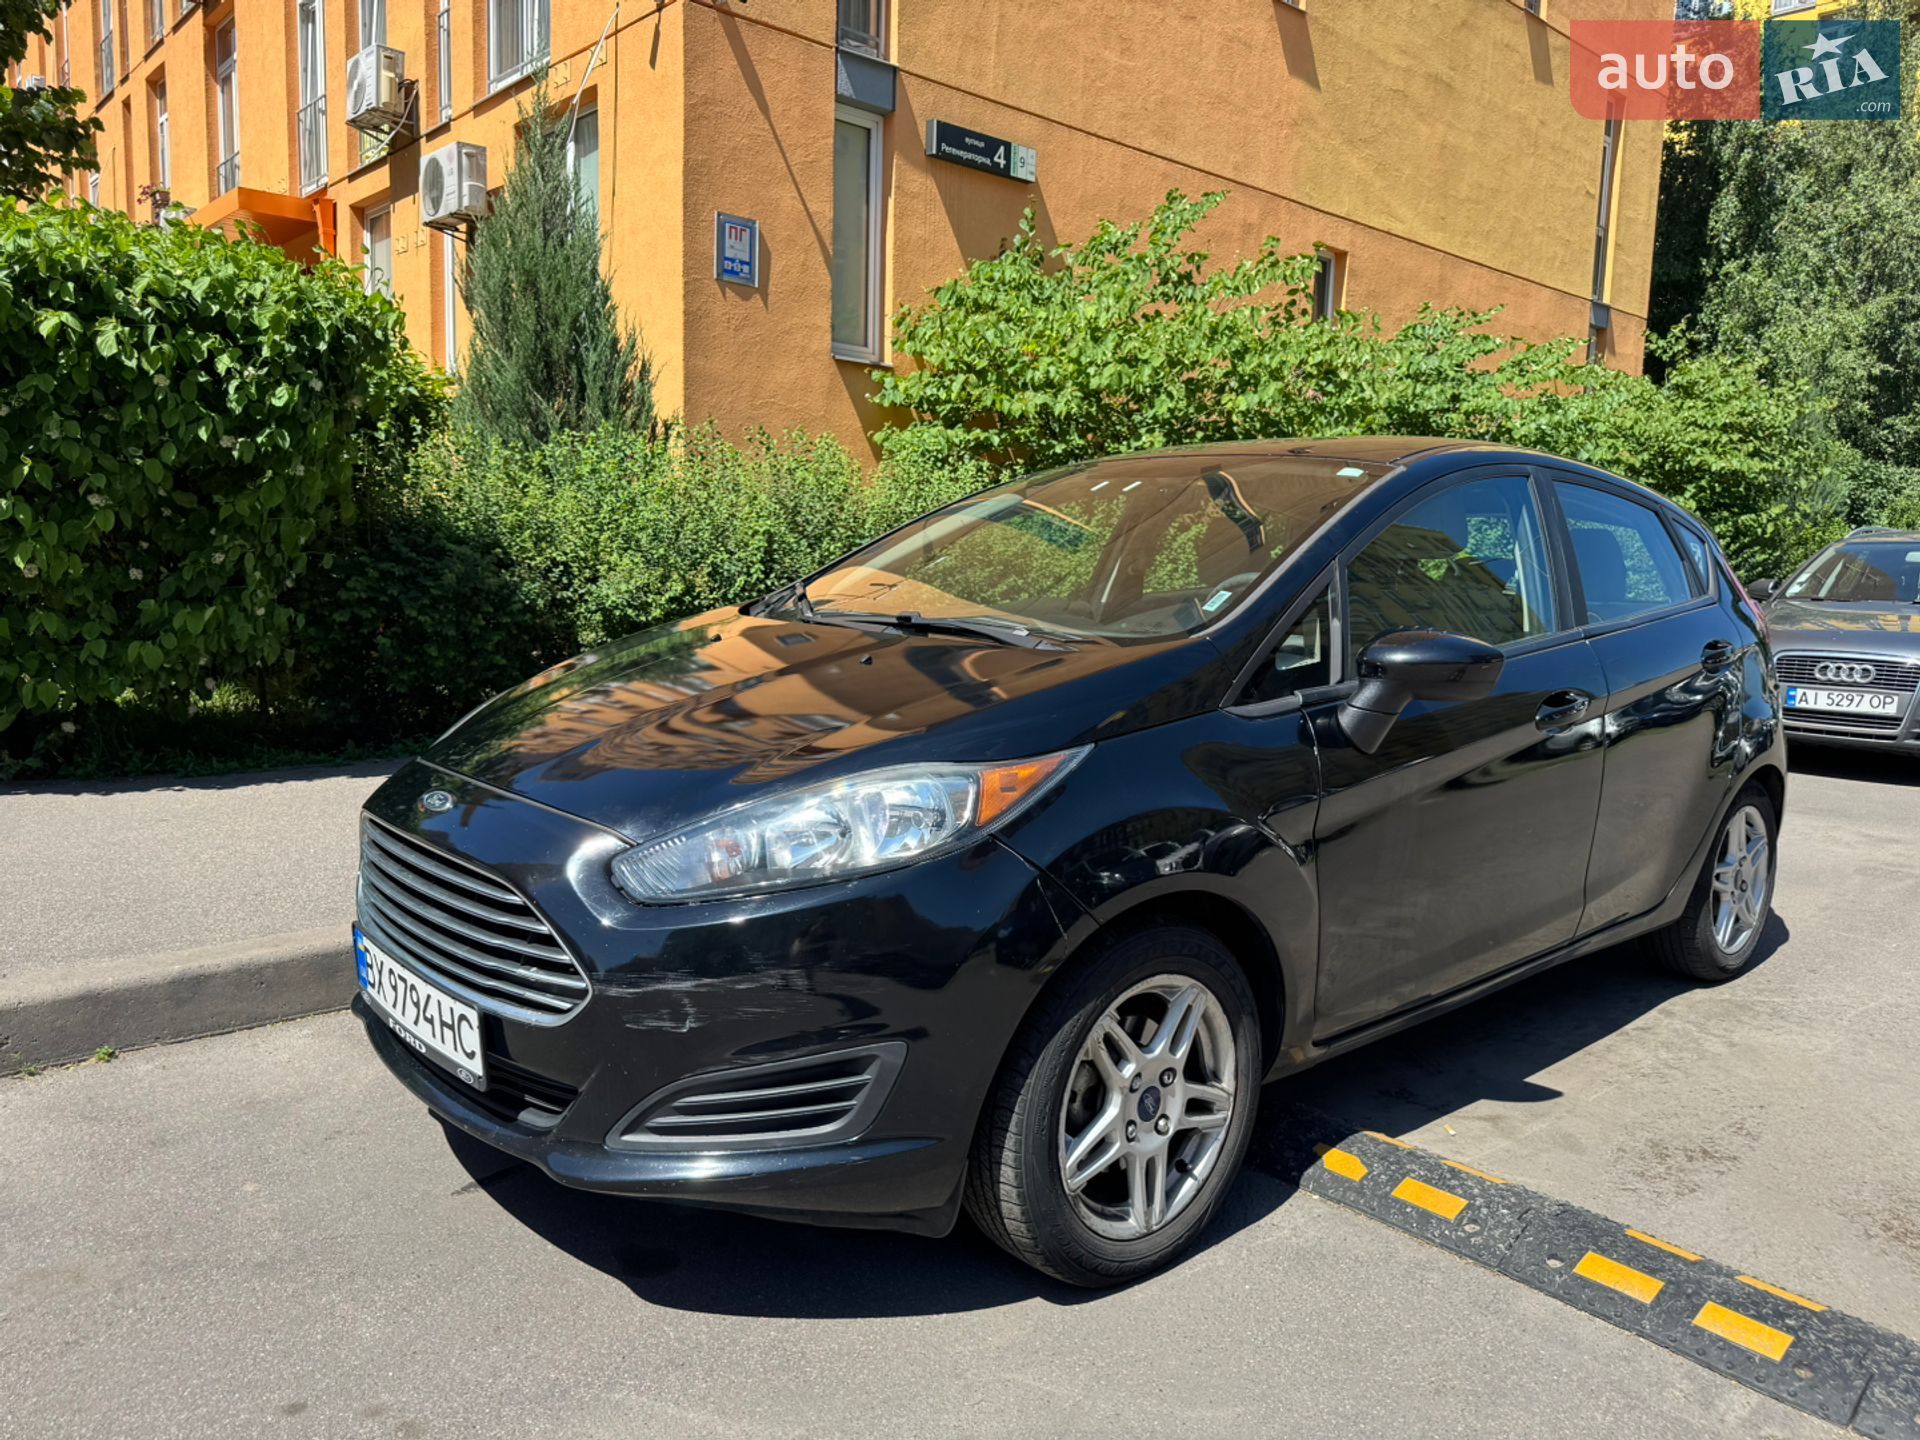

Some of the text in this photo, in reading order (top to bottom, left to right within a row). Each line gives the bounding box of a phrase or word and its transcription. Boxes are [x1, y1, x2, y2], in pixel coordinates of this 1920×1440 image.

[993, 145, 1007, 169] 4
[1826, 692, 1865, 709] 5297
[1869, 694, 1895, 710] OP
[388, 1017, 427, 1054] FORD
